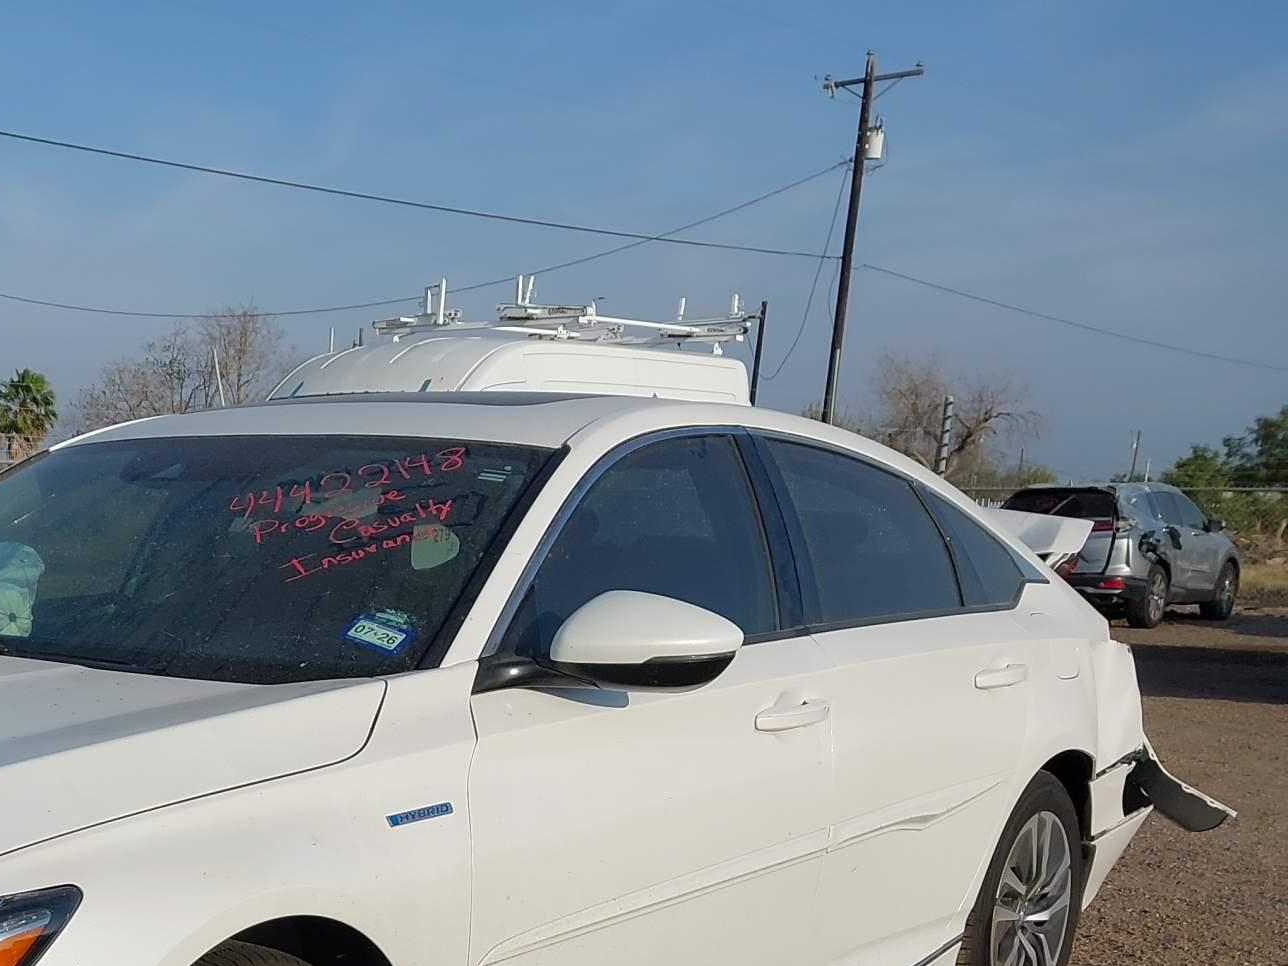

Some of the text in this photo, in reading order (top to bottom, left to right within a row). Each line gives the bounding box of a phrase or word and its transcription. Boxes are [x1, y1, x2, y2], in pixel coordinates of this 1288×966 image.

[228, 446, 467, 521] 44422148
[251, 489, 407, 544] Progrve
[329, 499, 454, 545] Casualty
[399, 803, 450, 824] HYBRID
